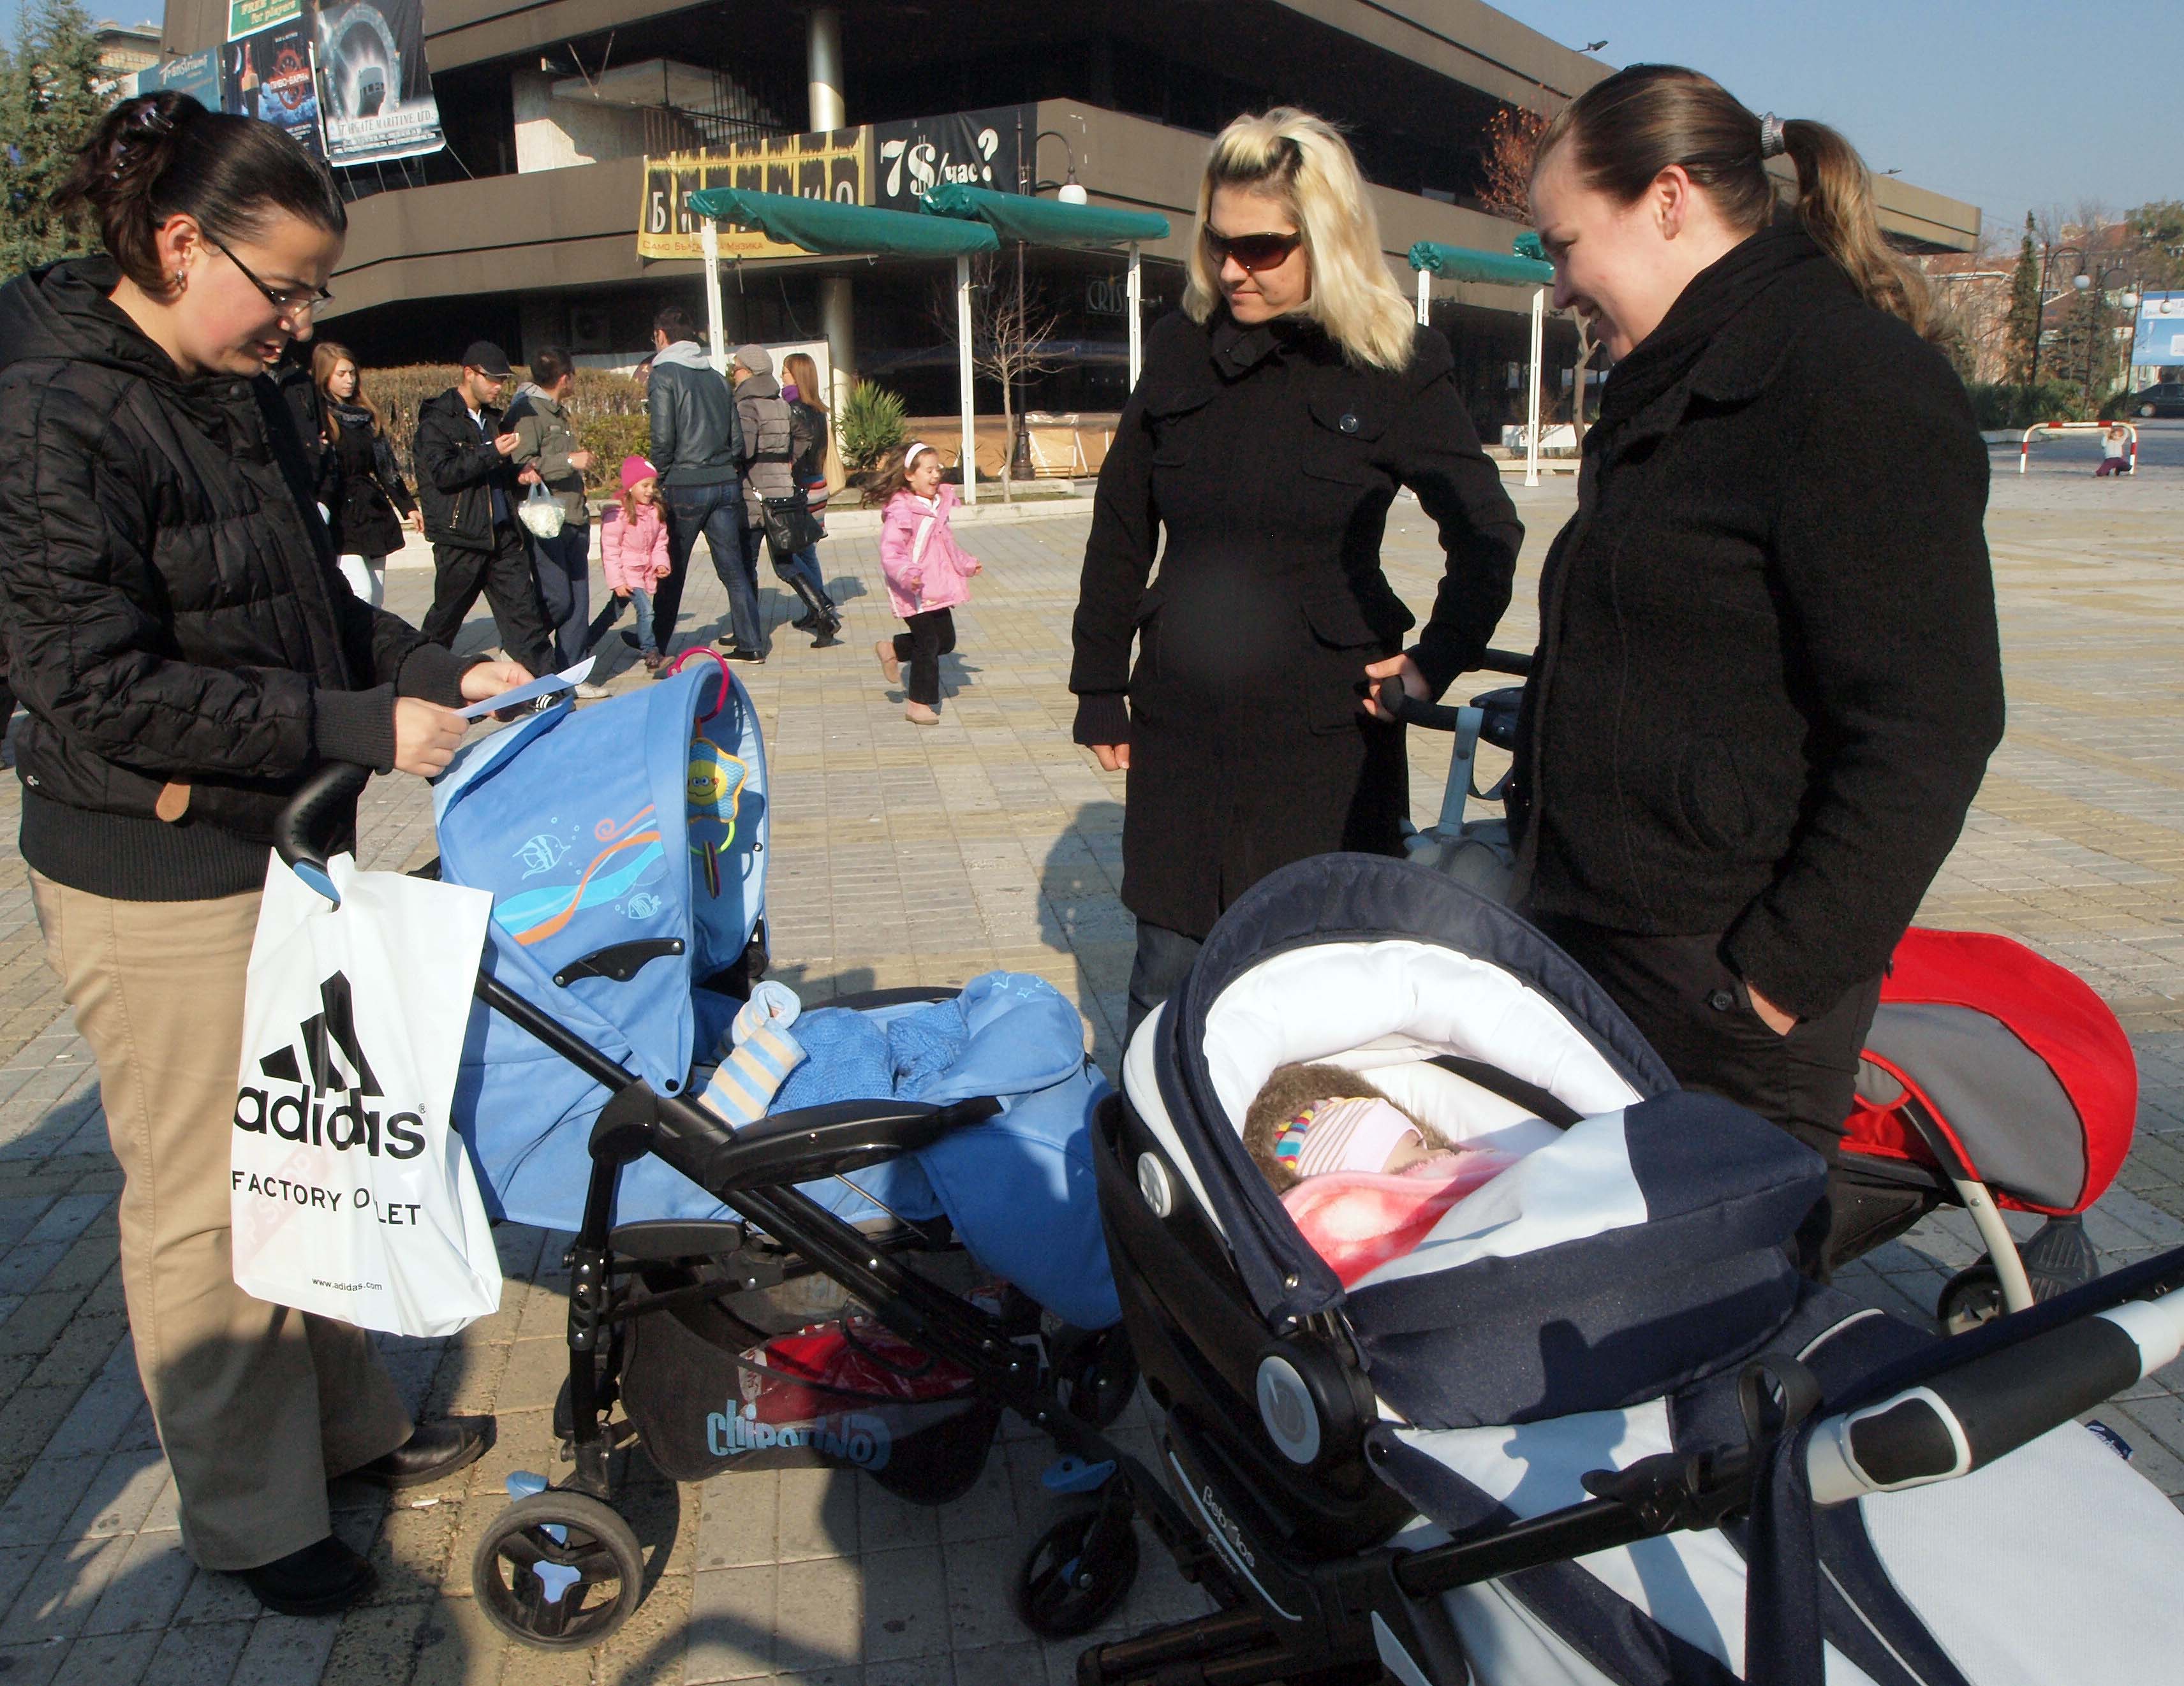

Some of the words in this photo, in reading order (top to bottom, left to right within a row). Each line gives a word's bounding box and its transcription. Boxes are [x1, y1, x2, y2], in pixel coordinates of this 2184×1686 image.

[233, 1083, 426, 1160] adidas
[232, 1170, 343, 1212] FACTORY
[353, 1187, 421, 1226] OLET
[312, 1278, 383, 1291] www.adidas.com
